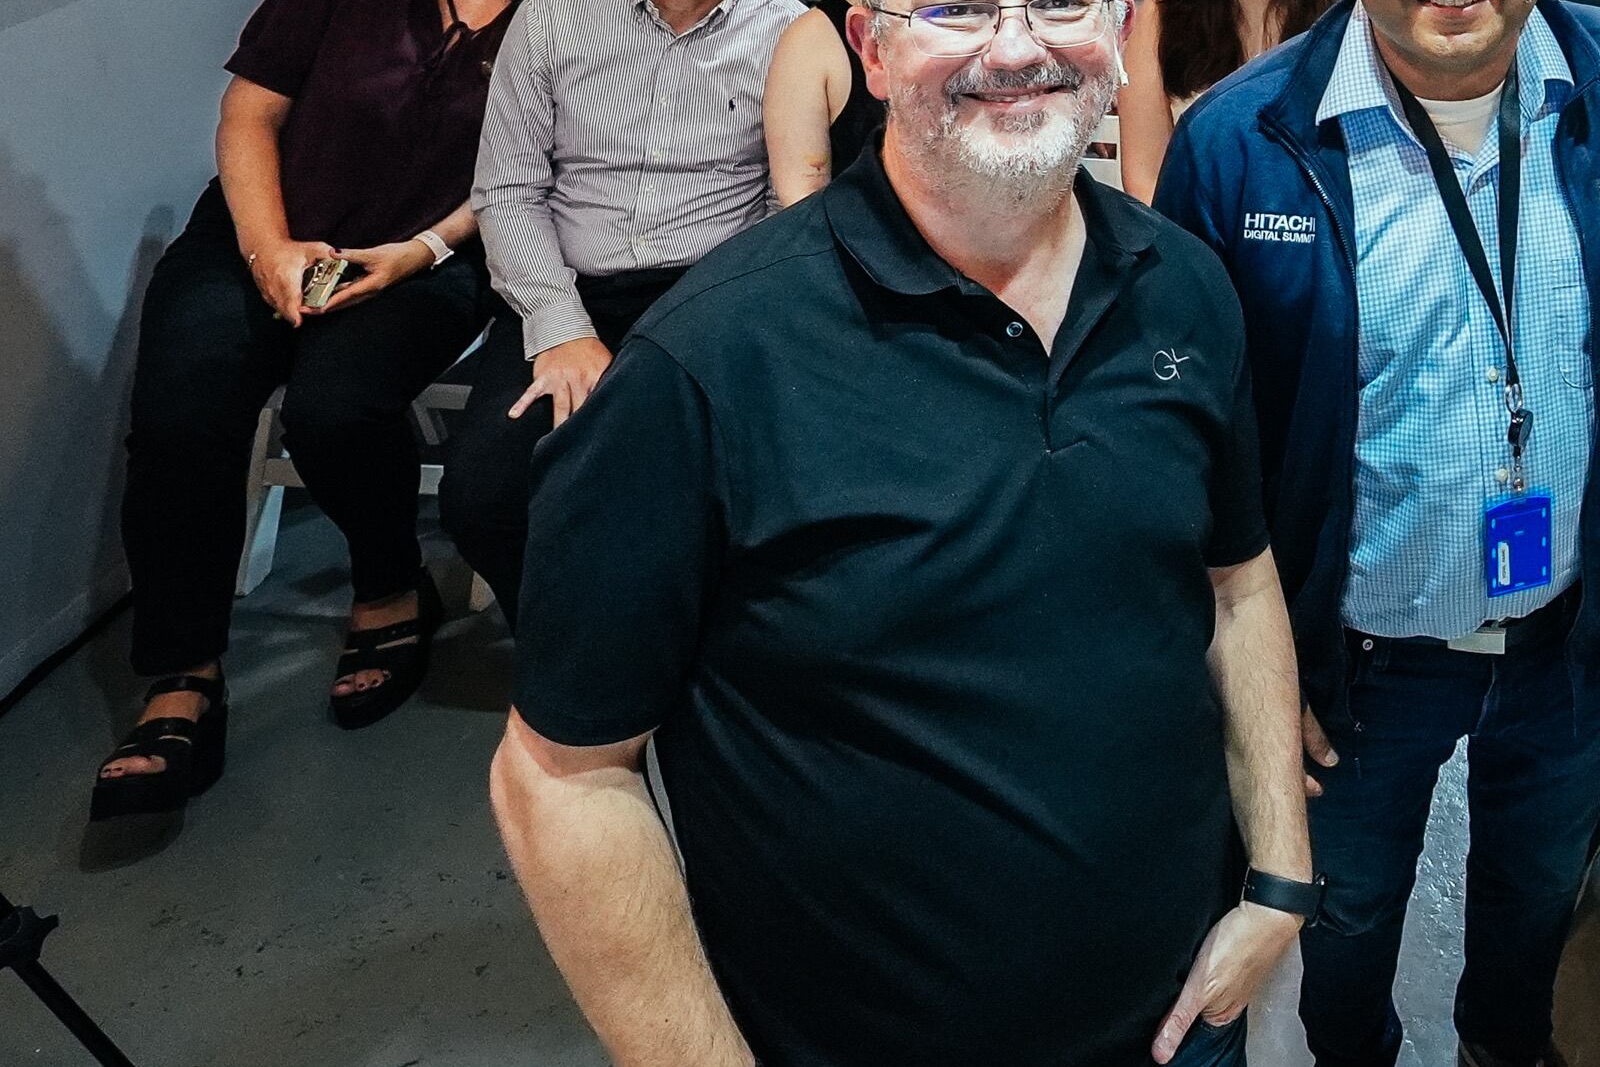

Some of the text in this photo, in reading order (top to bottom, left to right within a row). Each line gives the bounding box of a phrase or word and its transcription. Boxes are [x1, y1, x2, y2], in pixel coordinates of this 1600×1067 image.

[1244, 212, 1316, 232] HITACHI
[1243, 229, 1316, 244] DIGITAL SUMMIT
